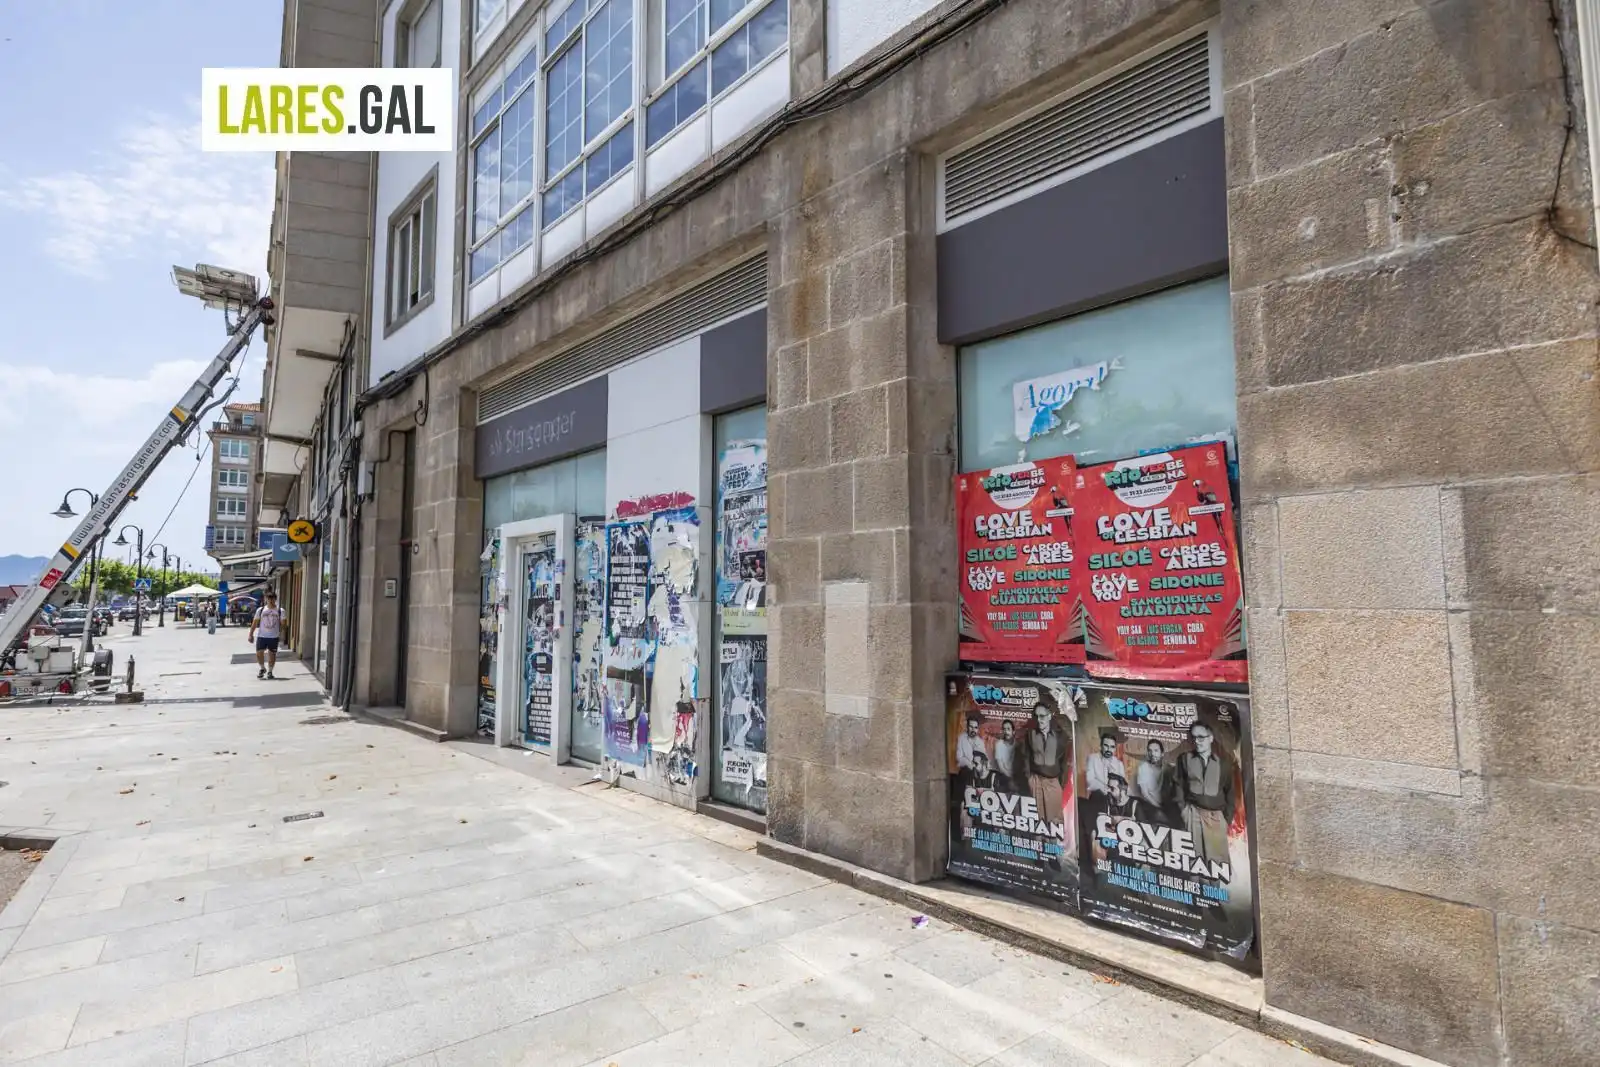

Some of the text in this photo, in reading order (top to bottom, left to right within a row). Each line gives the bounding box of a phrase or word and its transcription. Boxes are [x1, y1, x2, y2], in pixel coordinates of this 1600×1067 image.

[72, 420, 175, 546] www.mudanzasorganero.com
[975, 510, 1033, 532] LOVE
[1098, 507, 1172, 535] LOVE
[988, 522, 1052, 540] LESBIAN
[1114, 521, 1197, 544] LESBIAN
[1022, 542, 1069, 554] CARLOS
[1160, 542, 1220, 557] CARLOS
[1026, 549, 1074, 565] ARES
[1165, 550, 1227, 570] ARES
[968, 571, 1006, 584] LOVE
[1014, 568, 1071, 582] SIDONIE
[1150, 572, 1225, 589] SIDONIE
[970, 582, 992, 591] YOU
[1092, 579, 1139, 593] LOVE
[990, 593, 1060, 605] GUADIANA
[1094, 591, 1122, 601] YOU
[1120, 603, 1211, 618] GUADIANA
[1149, 729, 1180, 738] AGOSTO
[964, 787, 1039, 821] LOVE
[981, 810, 1064, 839] LESBIAN
[1096, 813, 1195, 857] LOVE
[1101, 837, 1230, 881] OF LESBIAN
[1159, 874, 1183, 890] CARLOS
[1184, 881, 1200, 895] ARES
